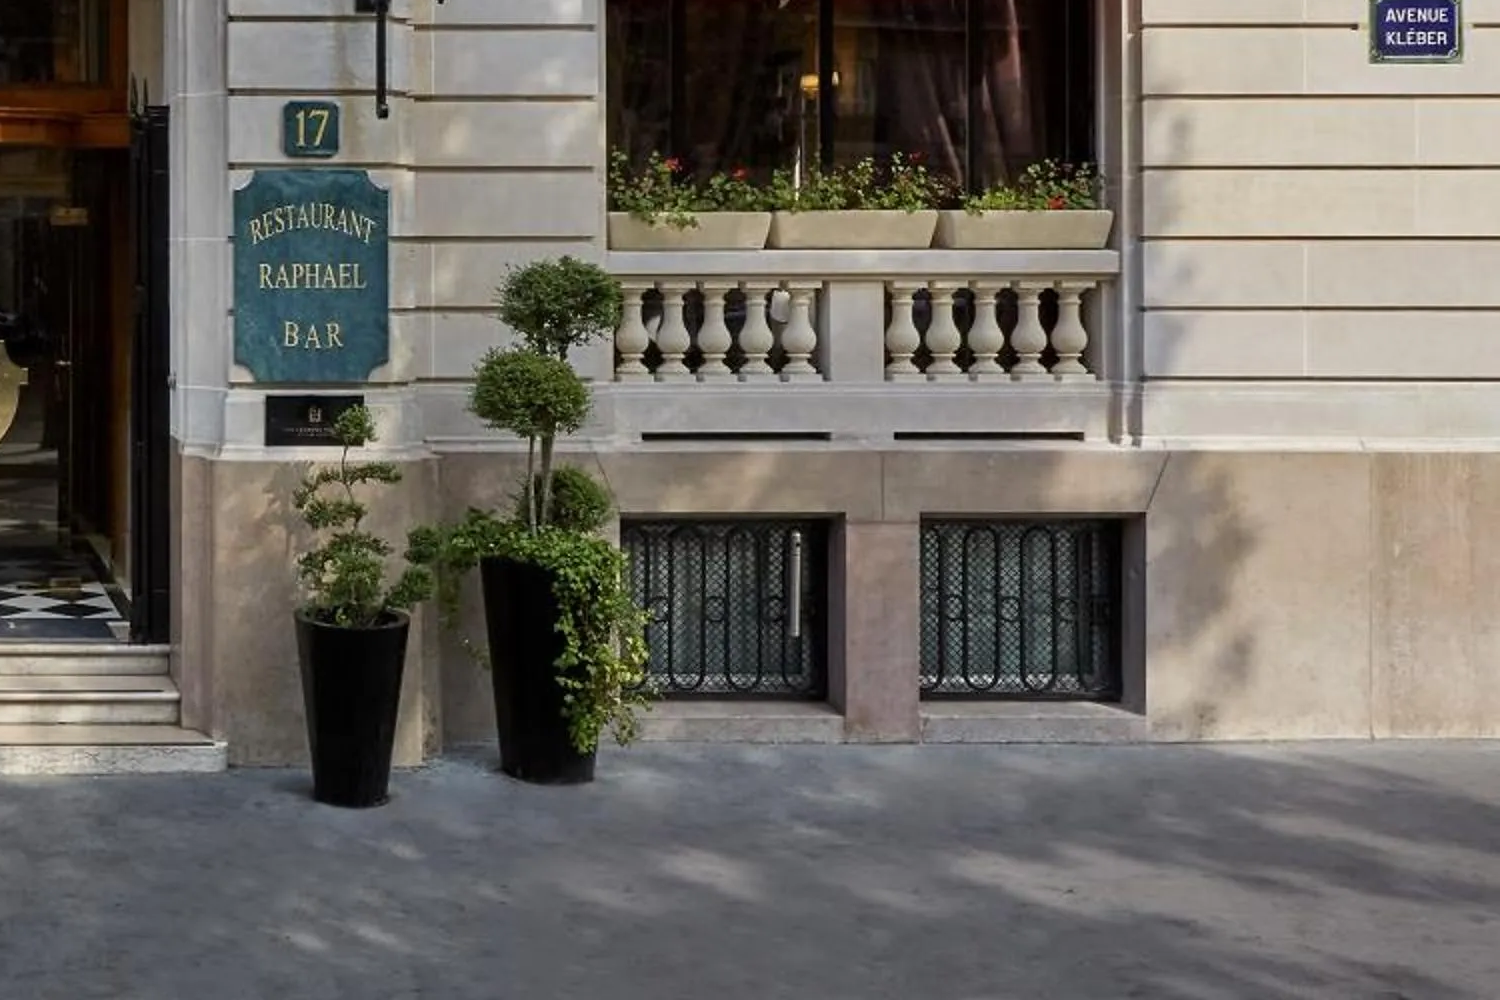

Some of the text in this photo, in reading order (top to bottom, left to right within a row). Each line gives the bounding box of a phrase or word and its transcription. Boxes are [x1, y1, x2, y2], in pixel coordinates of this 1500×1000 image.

[1385, 7, 1449, 23] AVENUE
[1385, 27, 1448, 45] KLÉBER
[295, 109, 330, 148] 17
[249, 203, 377, 245] RESTAURANT
[258, 263, 367, 290] RAPHAEL
[284, 320, 345, 349] BAR
